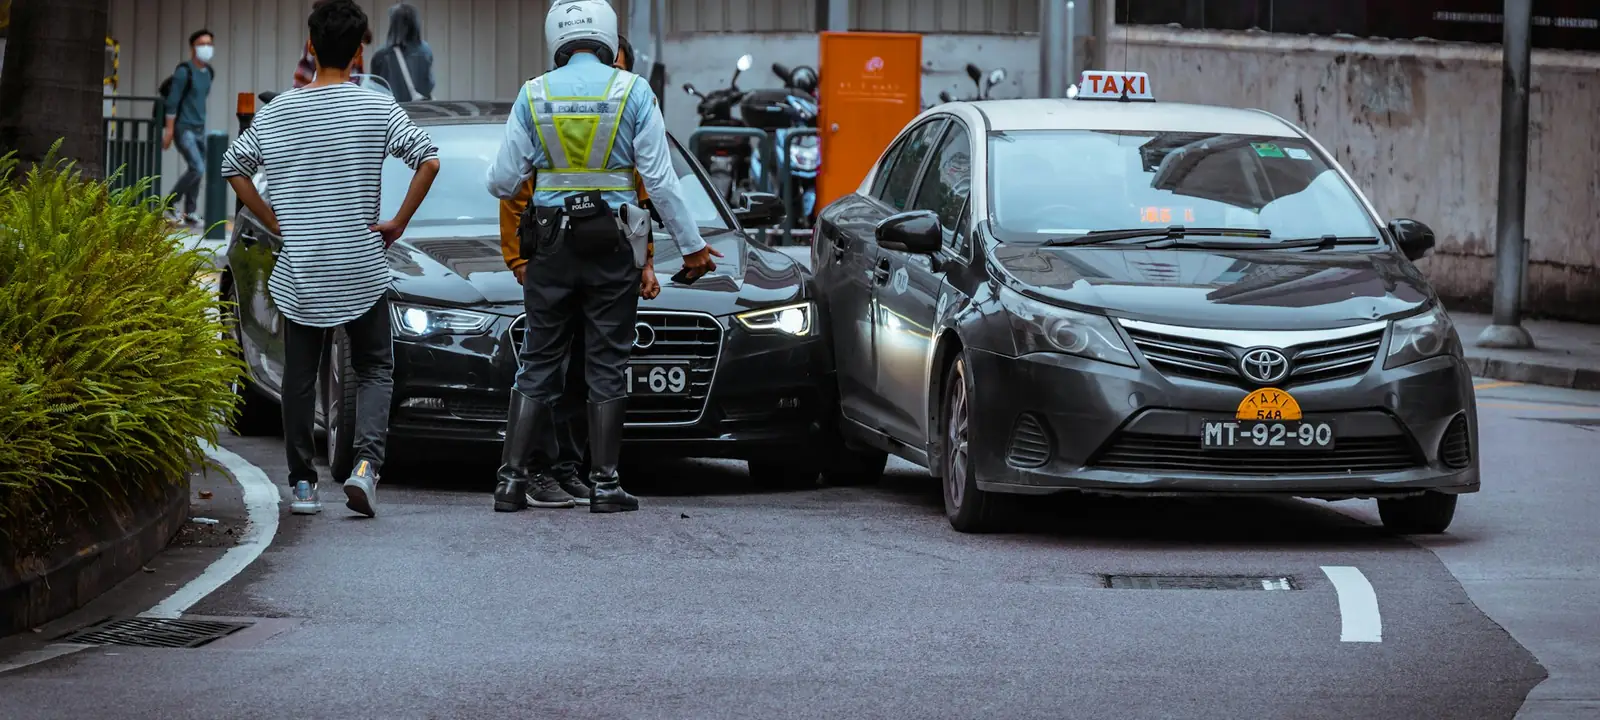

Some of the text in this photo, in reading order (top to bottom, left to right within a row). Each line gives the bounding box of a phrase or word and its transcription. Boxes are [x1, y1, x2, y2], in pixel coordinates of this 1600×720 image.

[1088, 75, 1145, 95] TAXI
[1248, 392, 1289, 408] TAXI
[1256, 410, 1282, 420] 548
[1205, 422, 1332, 446] MT-92-90
